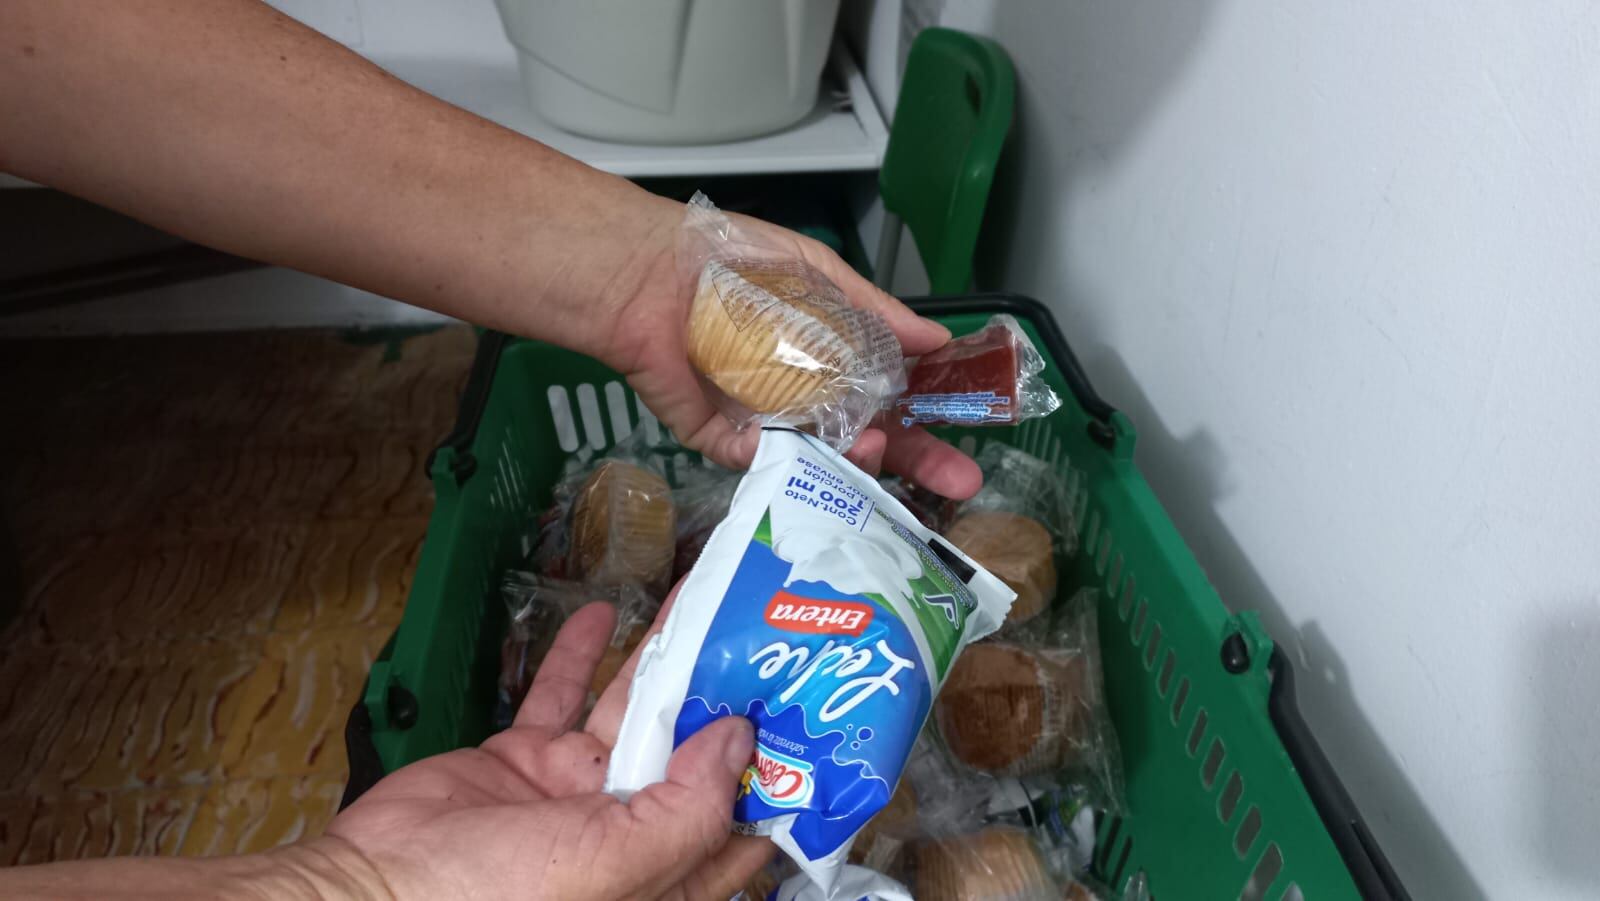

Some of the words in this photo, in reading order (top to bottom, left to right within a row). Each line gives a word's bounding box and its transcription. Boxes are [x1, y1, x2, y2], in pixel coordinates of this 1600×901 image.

[787, 476, 815, 492] ml
[797, 457, 844, 484] envase
[803, 468, 855, 500] porción
[820, 490, 861, 517] 200
[857, 500, 864, 510] 1
[770, 604, 866, 629] Entera
[749, 640, 915, 722] Leche
